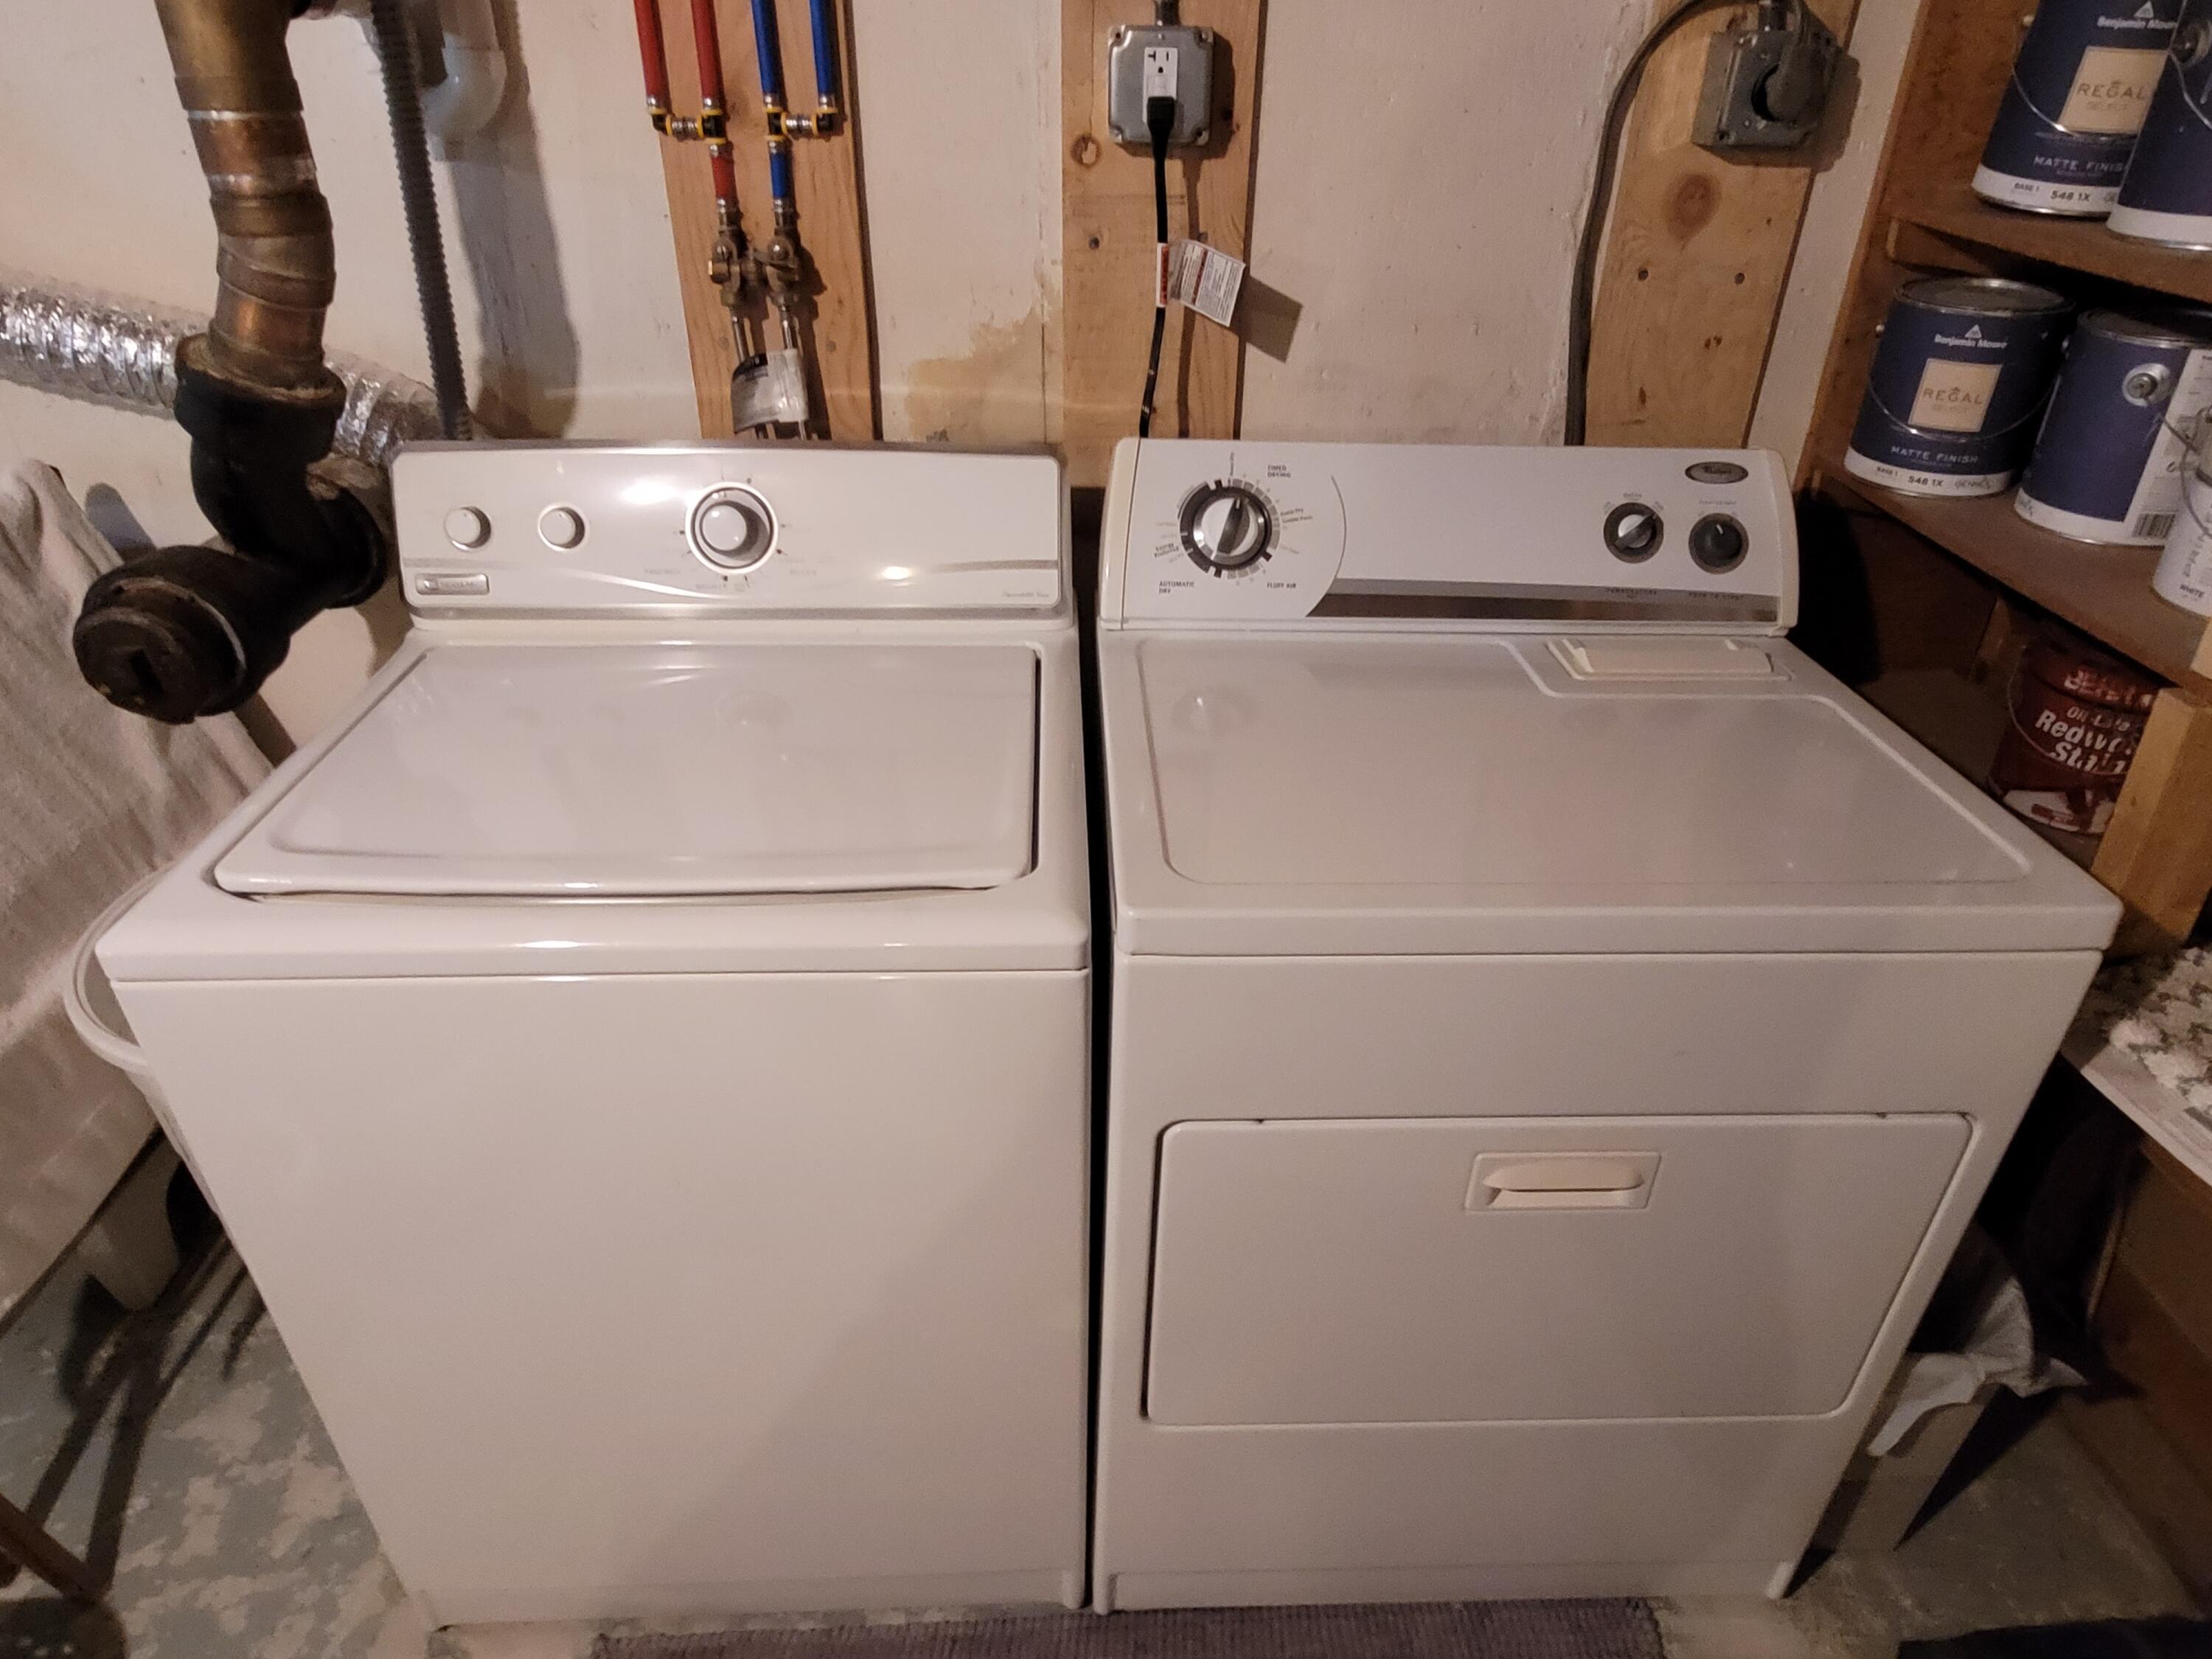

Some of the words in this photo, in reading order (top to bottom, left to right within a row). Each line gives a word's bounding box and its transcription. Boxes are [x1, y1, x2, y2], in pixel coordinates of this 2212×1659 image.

[2076, 82, 2146, 100] REGAL
[2033, 155, 2079, 171] MATTE
[2085, 160, 2128, 173] FINIS
[2050, 189, 2075, 202] 548
[1933, 333, 1976, 347] Benjamin
[1977, 338, 2008, 349] Moore
[1922, 387, 1983, 406] REGAL
[1891, 445, 1931, 460] MATTE
[1935, 452, 1979, 465] FINISH
[1907, 475, 1929, 487] 548
